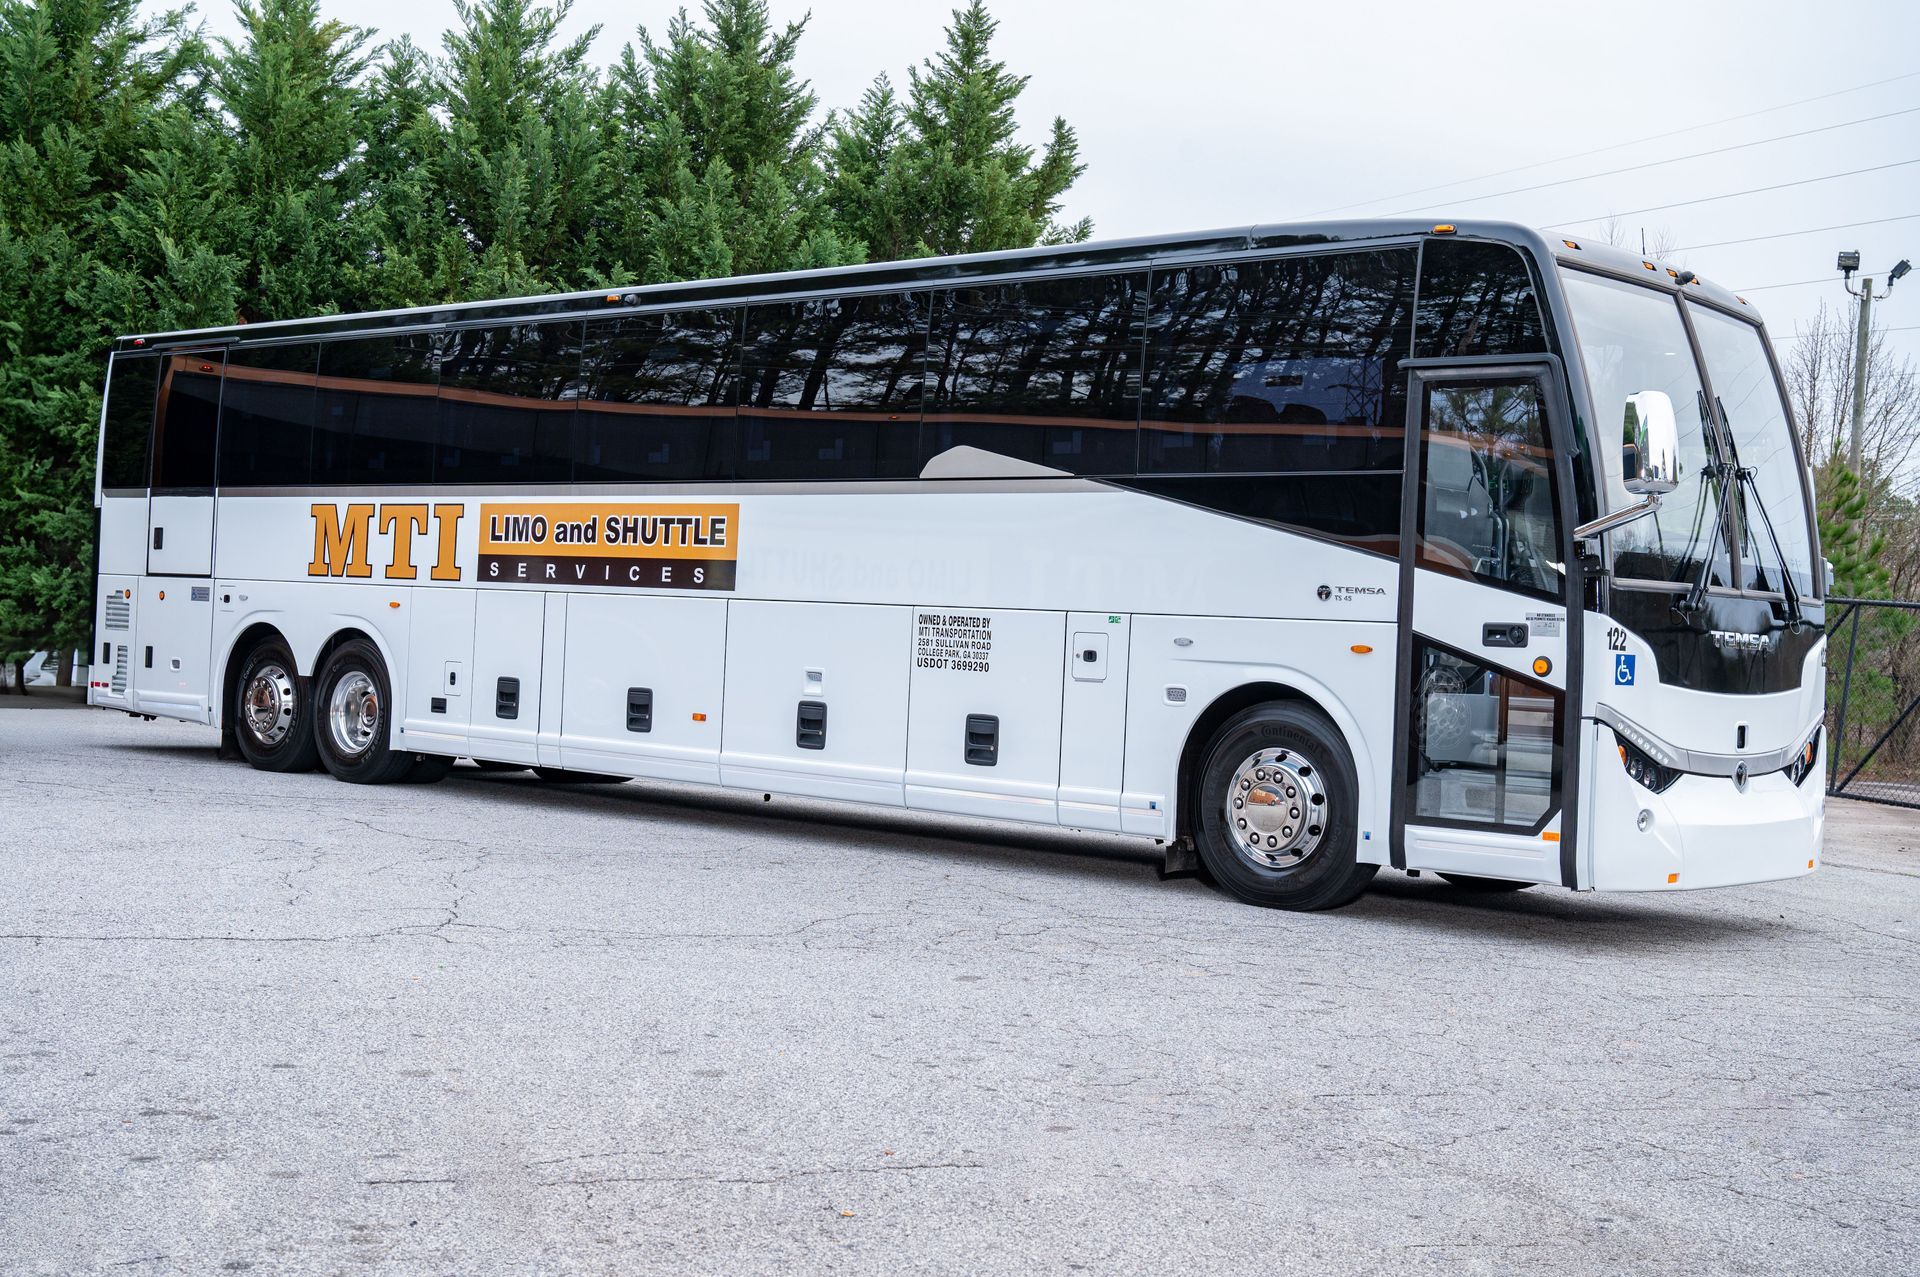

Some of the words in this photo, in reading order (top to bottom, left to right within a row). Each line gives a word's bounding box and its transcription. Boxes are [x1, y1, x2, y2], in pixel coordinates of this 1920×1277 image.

[489, 515, 547, 543] LIMO
[554, 516, 597, 545] and
[604, 516, 728, 548] SHUTTLE
[307, 503, 464, 581] MTI
[490, 561, 705, 584] SERVICES
[1335, 586, 1386, 595] TEMSA
[919, 614, 940, 626] OWNED
[942, 615, 947, 626] &
[948, 616, 980, 628] OPERATED
[982, 617, 991, 628] BY
[919, 626, 931, 637] MTI
[932, 627, 992, 640] TRANSPORTATION
[1607, 627, 1627, 651] 122
[1711, 630, 1772, 652] TEMSA
[918, 638, 933, 647] 2581
[936, 639, 969, 649] SULLIVAN
[971, 642, 991, 651] ROAD
[918, 647, 943, 657] COLLEGE
[945, 649, 961, 659] PARK,
[963, 650, 971, 659] GA
[973, 651, 989, 660] 30337
[917, 657, 949, 669] USDOT
[951, 660, 990, 672] 3699290
[1261, 725, 1319, 750] Continental
